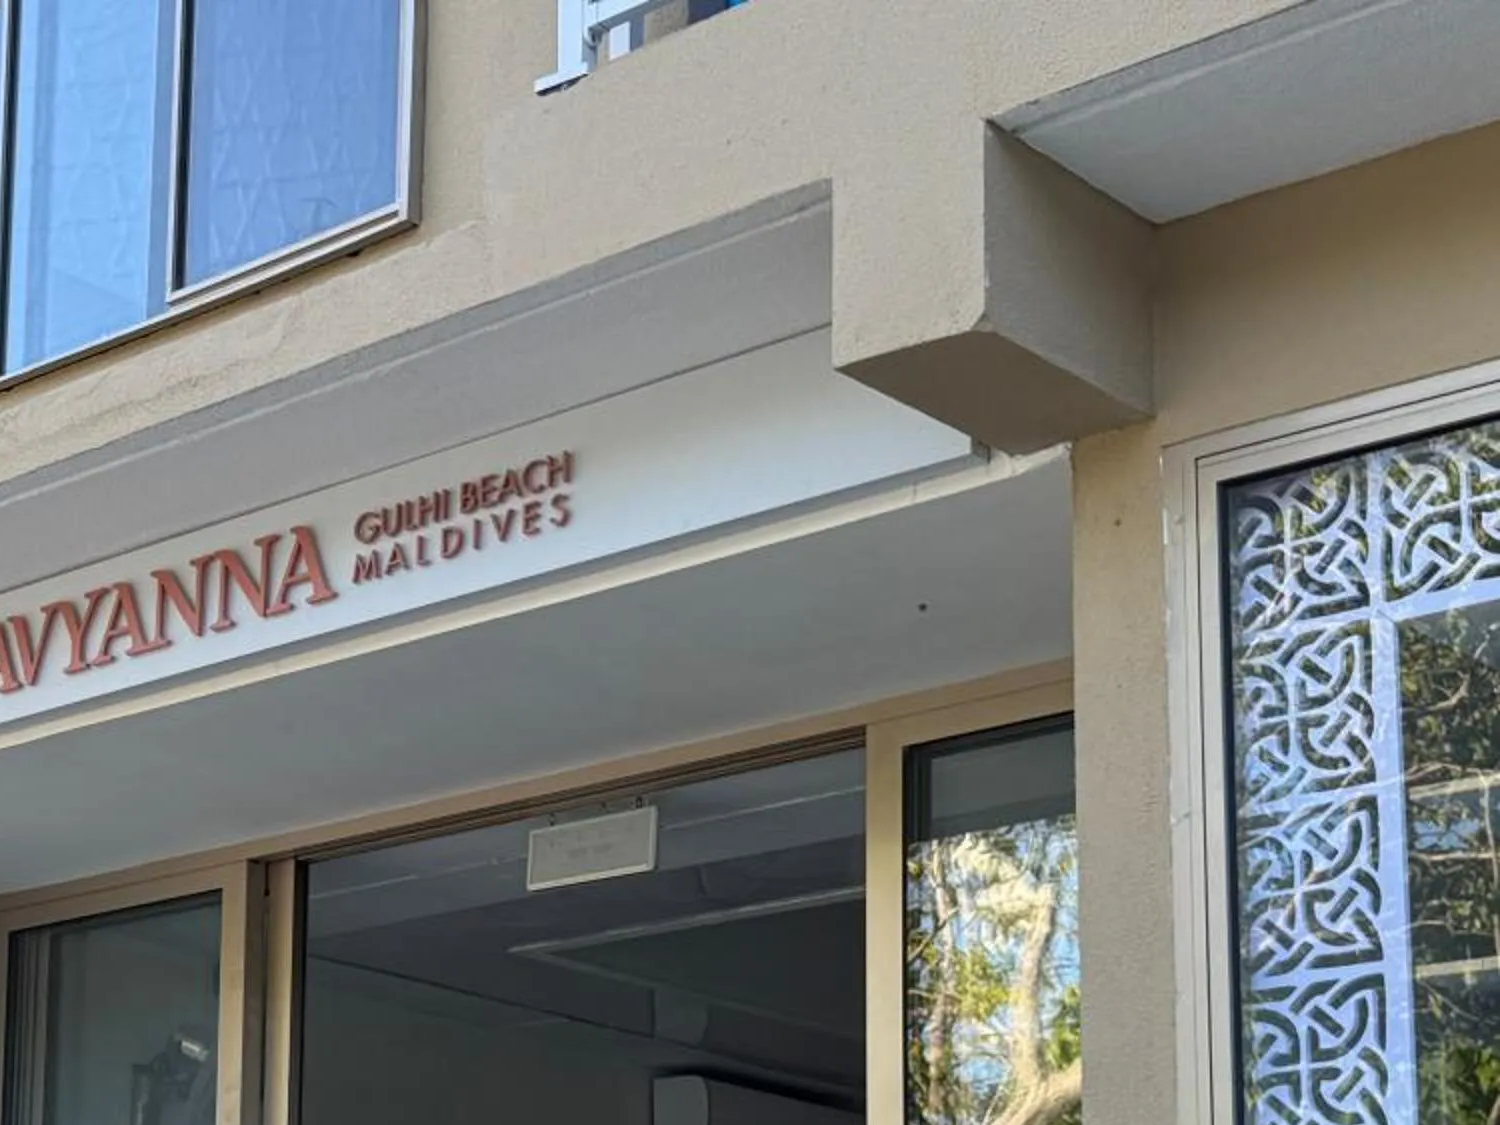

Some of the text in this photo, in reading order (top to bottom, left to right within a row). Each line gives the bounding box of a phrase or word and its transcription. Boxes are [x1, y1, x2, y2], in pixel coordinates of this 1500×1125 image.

[351, 493, 573, 585] MALDIVES
[353, 450, 577, 545] GULHI BEACH
